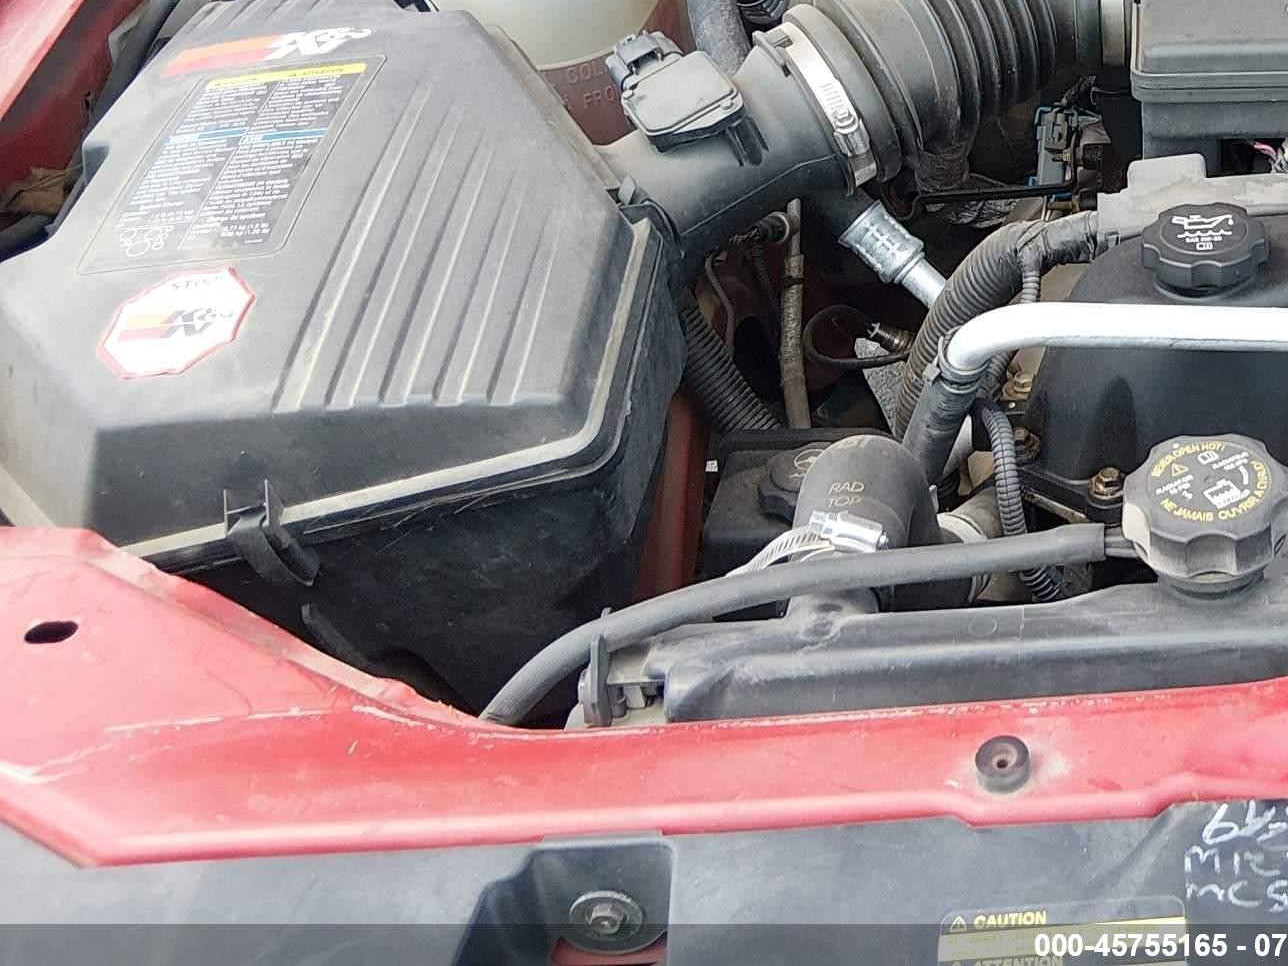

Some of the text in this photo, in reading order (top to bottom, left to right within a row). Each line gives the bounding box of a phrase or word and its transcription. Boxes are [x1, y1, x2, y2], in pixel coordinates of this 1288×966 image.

[567, 62, 608, 84] COL
[828, 480, 865, 495] RAD
[828, 496, 863, 508] TOP
[973, 910, 1047, 930] CAUTION
